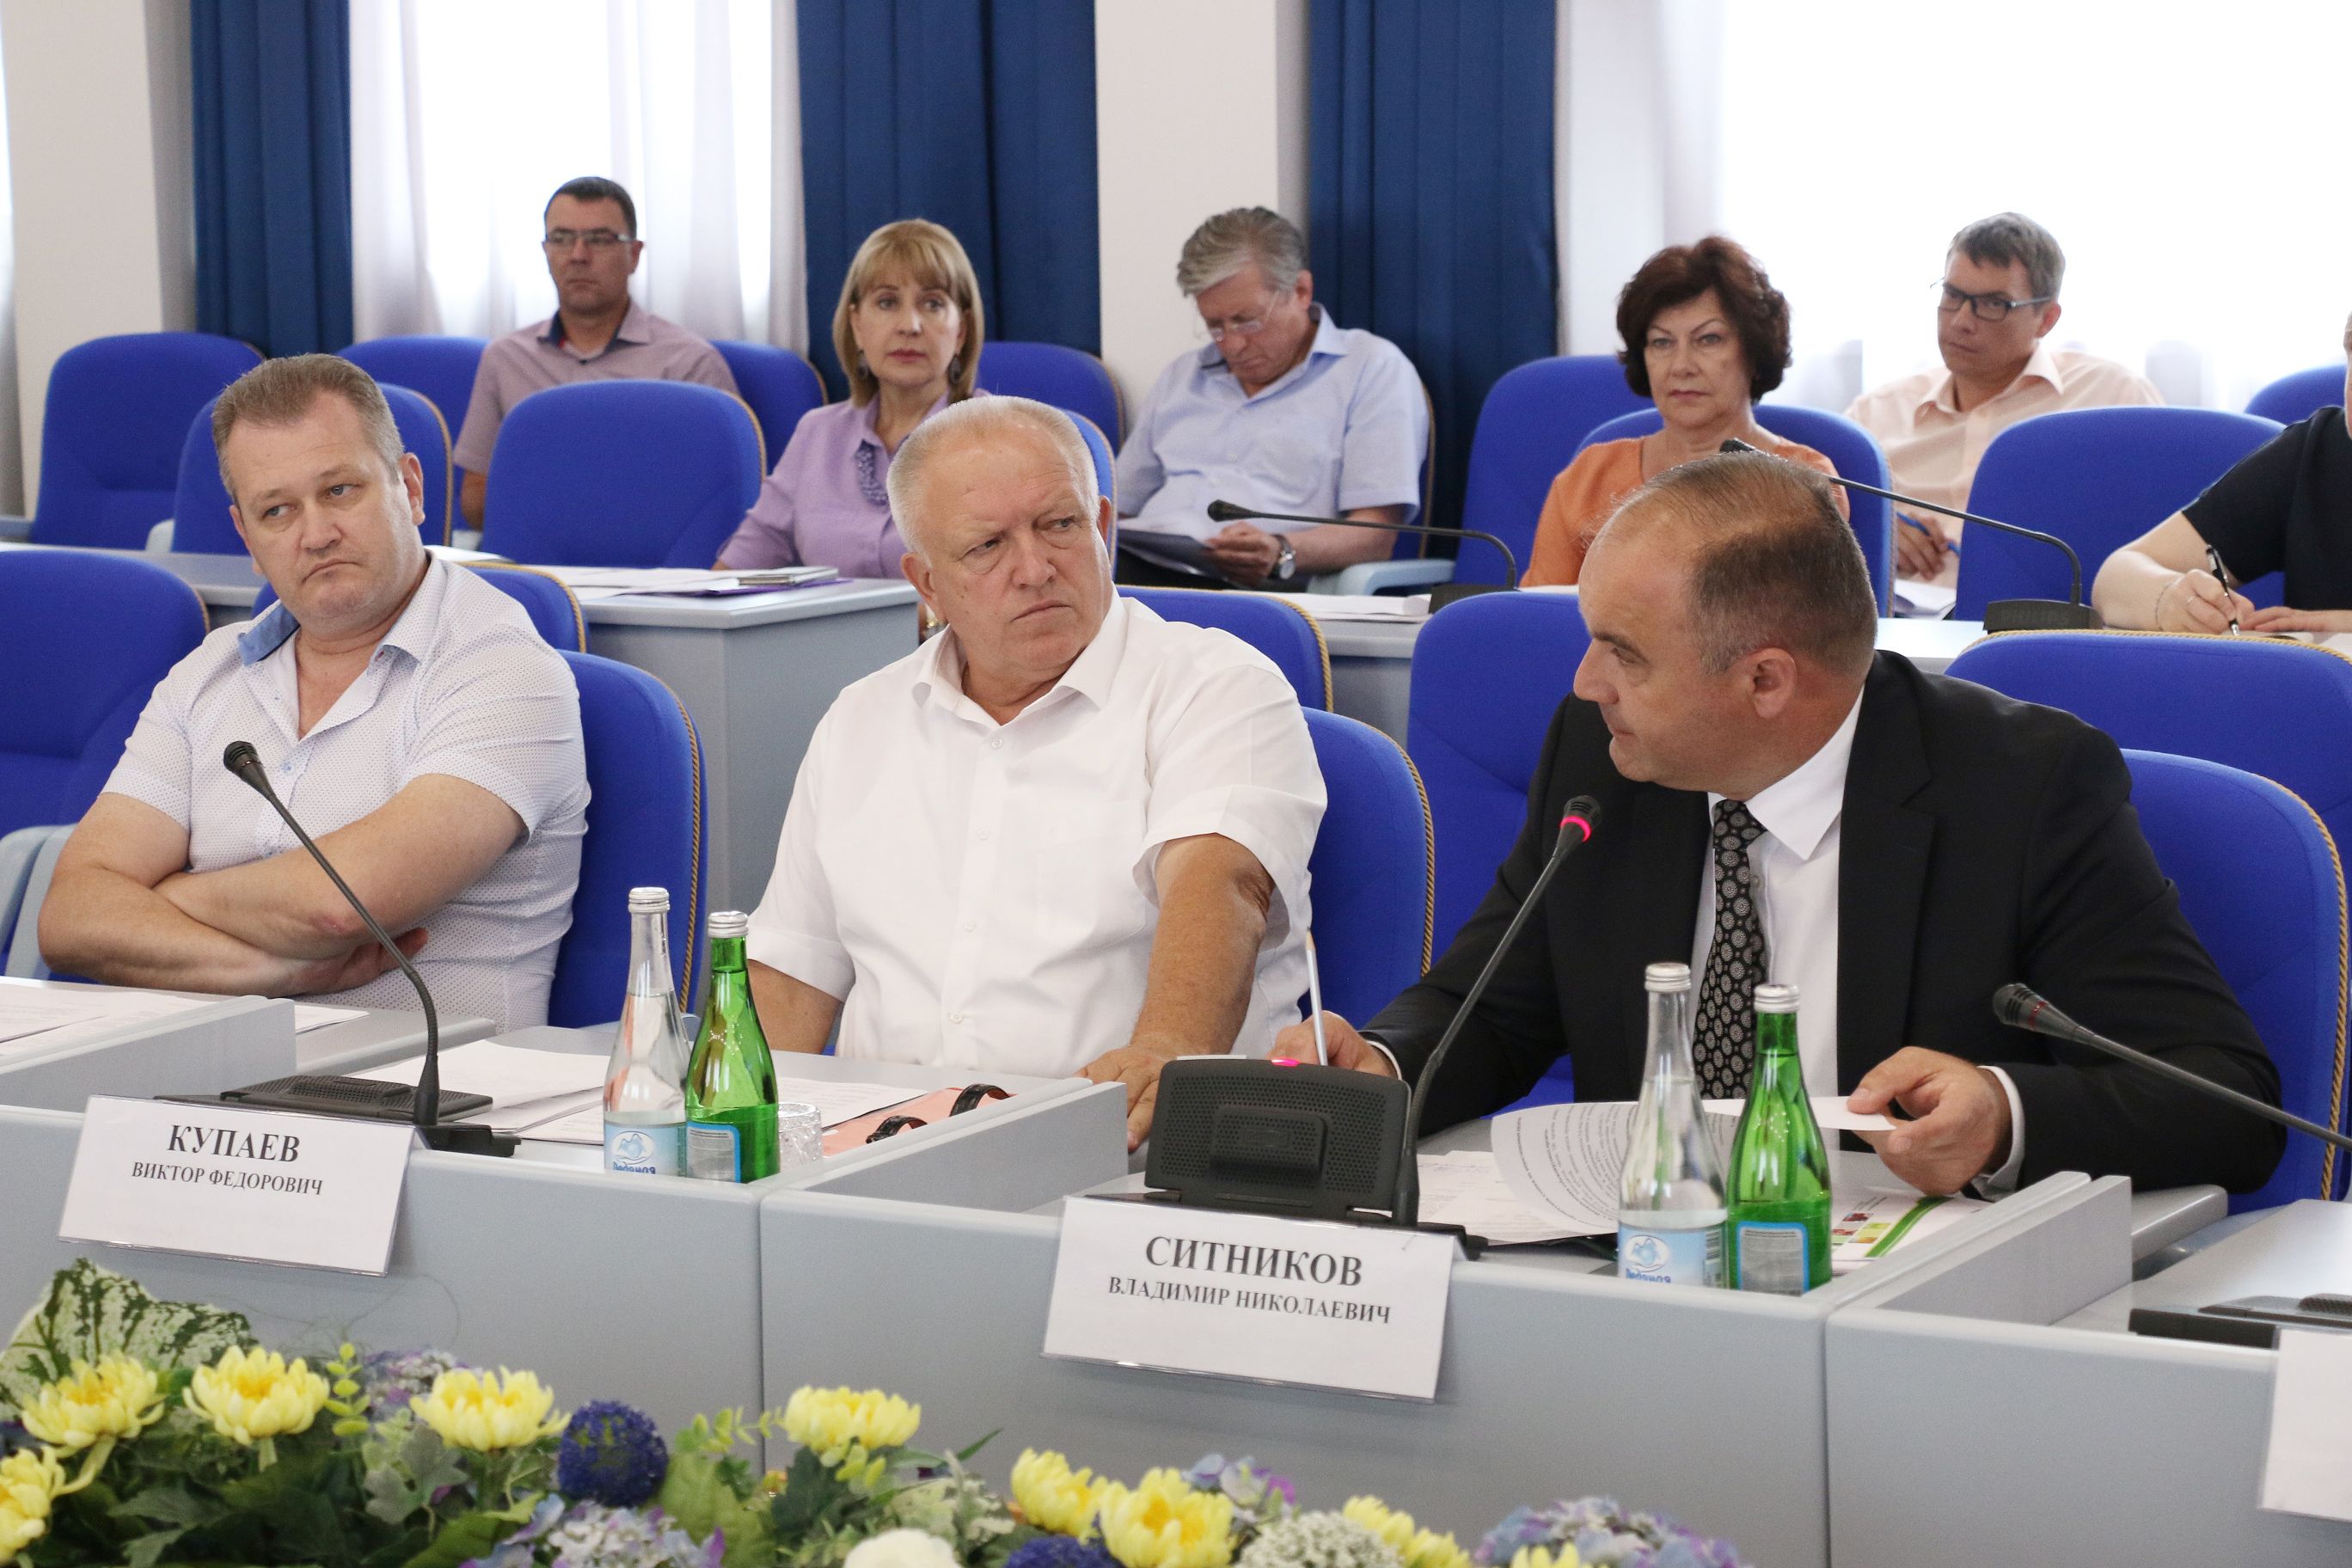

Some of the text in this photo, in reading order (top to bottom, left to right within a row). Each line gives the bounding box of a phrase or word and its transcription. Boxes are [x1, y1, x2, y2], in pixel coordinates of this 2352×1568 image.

[167, 1124, 300, 1162] КУПАЕВ
[132, 1161, 323, 1195] ВИКТОР ФЕДОРОВИЧ
[1146, 1236, 1362, 1286] СИТНИКОВ
[1109, 1277, 1391, 1325] ВЛАДИМИР НИКОЛАЕВИЧ
